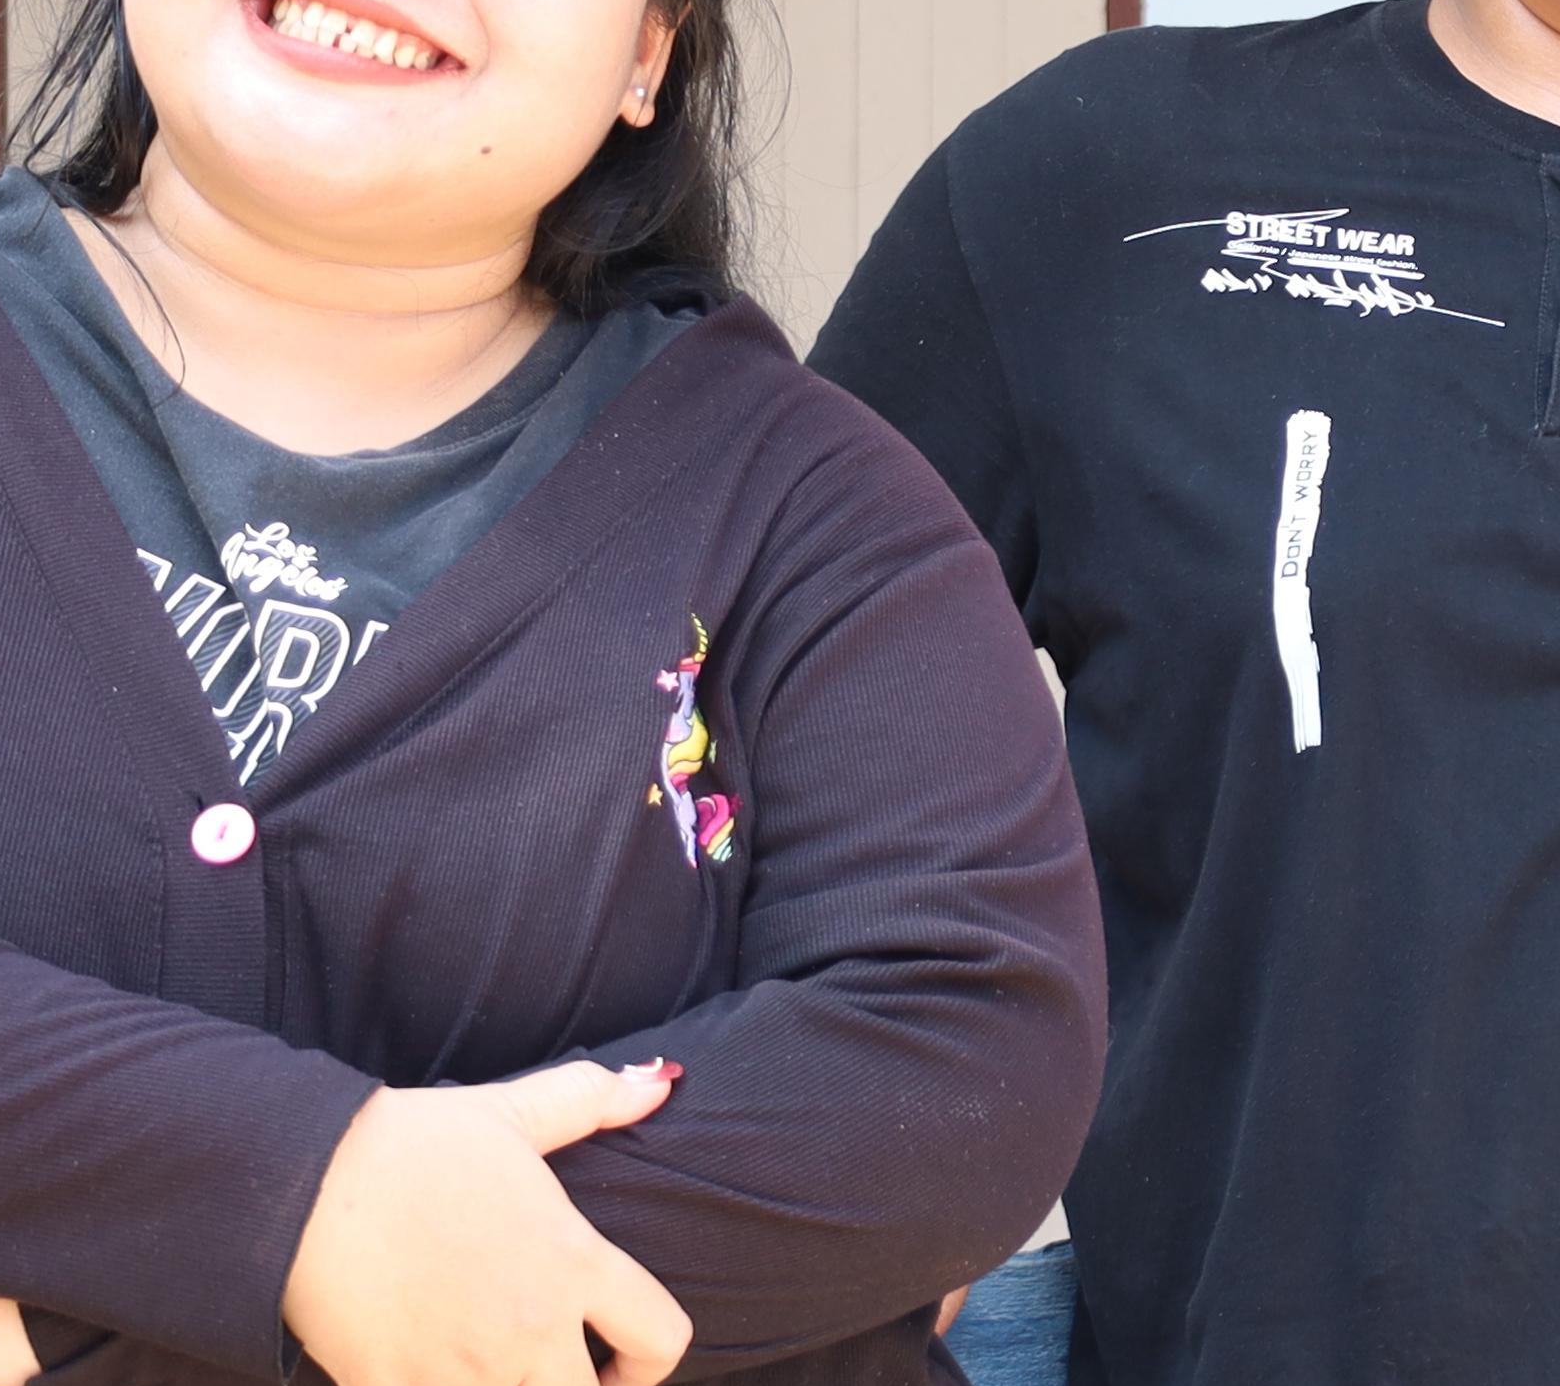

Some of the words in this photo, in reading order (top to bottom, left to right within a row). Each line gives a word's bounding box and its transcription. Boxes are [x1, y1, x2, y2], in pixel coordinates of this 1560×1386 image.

[1226, 212, 1331, 248] STREET
[1337, 229, 1415, 256] WEAR
[1280, 515, 1306, 579] DON'T
[1294, 430, 1318, 502] WORRY
[221, 531, 349, 601] Angeles
[244, 521, 319, 569] Los
